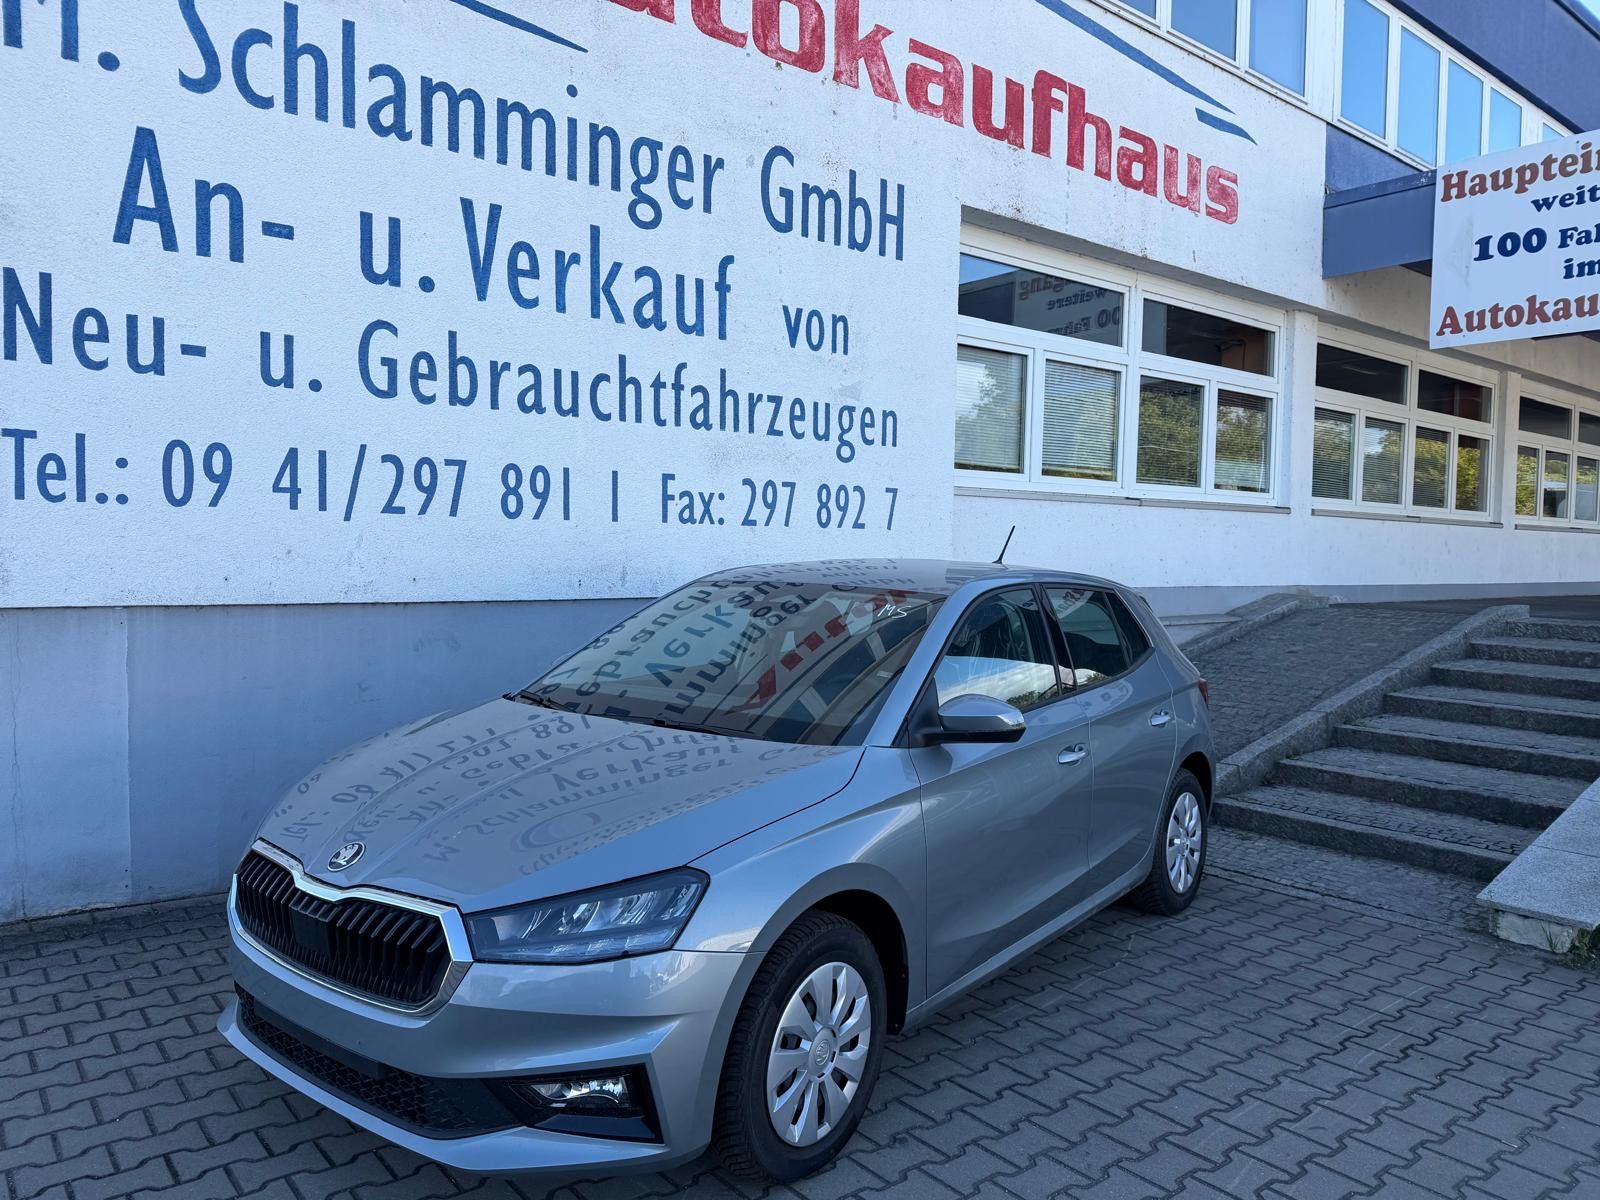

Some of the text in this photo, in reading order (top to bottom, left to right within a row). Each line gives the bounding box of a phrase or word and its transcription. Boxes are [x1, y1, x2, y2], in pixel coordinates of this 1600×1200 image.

[178, 0, 724, 230] Schlamminger
[760, 145, 905, 261] GmbH
[606, 0, 1239, 224] okaufhaus
[1440, 141, 1600, 202] Hauptei
[113, 126, 849, 355] An- u. Verkauf von
[1436, 293, 1600, 336] Autokau
[1473, 222, 1600, 261] 100 Fa
[3, 267, 898, 463] Neu- u. Gebrauchtfahrzeugen
[0, 428, 128, 504] Tel.:
[162, 440, 232, 507] 09
[272, 444, 467, 521] 41/297
[501, 463, 570, 520] 891
[661, 473, 725, 525] Fax:
[741, 478, 796, 527] 297
[817, 483, 865, 529] 892
[885, 487, 898, 530] 7
